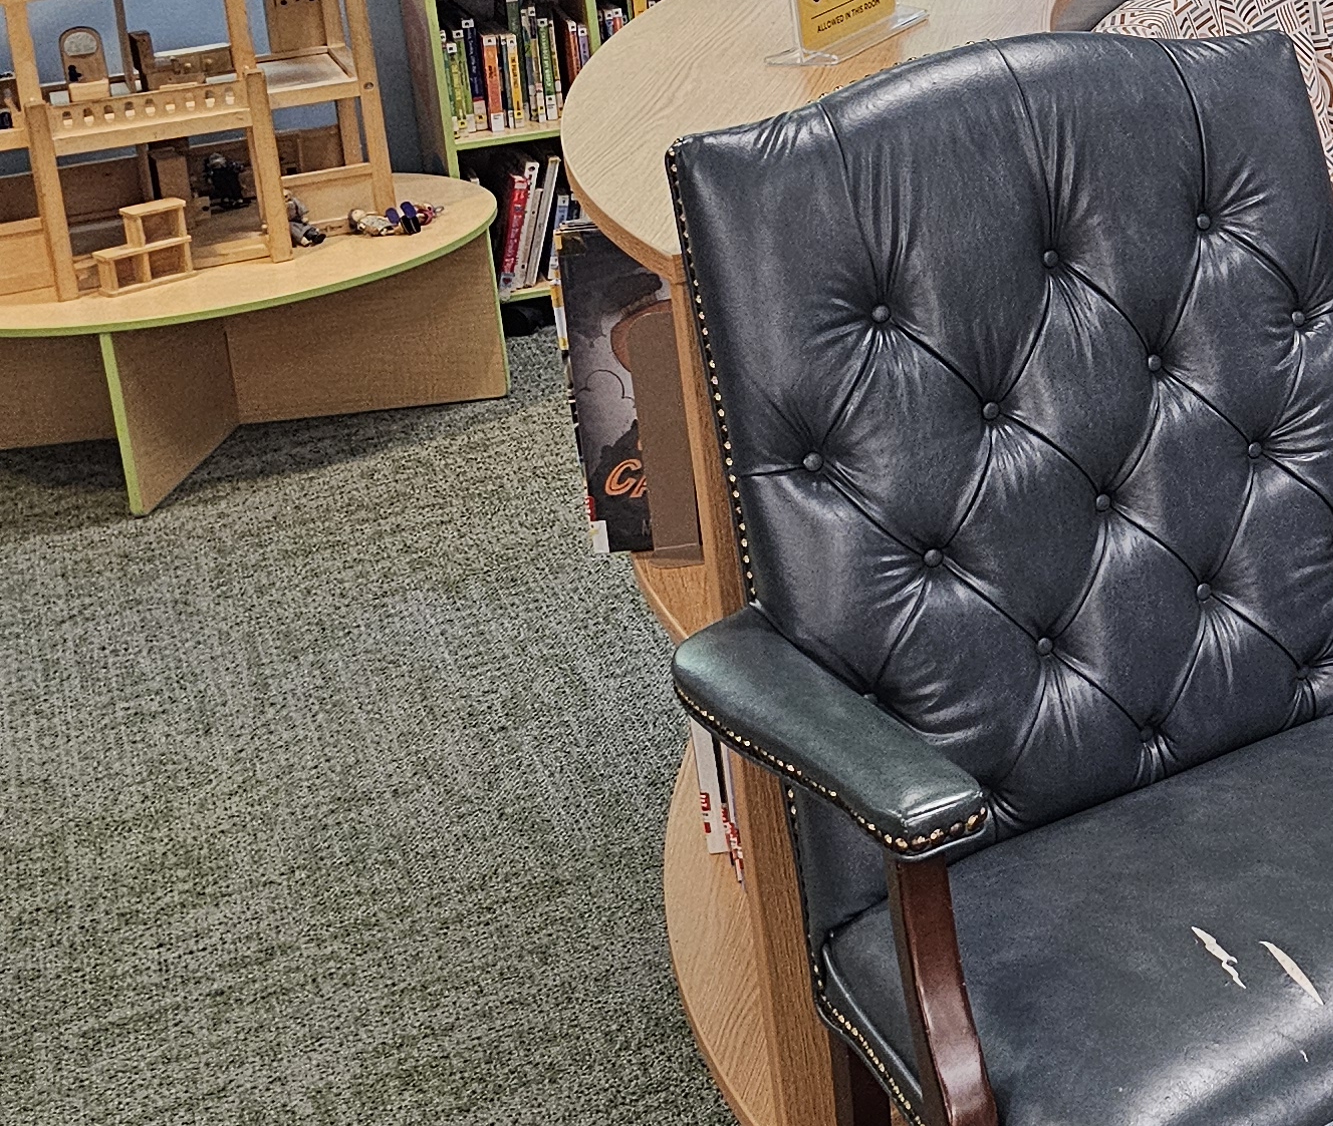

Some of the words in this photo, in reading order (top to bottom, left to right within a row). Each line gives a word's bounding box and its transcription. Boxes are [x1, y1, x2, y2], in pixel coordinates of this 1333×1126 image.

[816, 15, 845, 35] ALLOWED
[845, 11, 851, 23] IN
[852, 4, 864, 20] THIS
